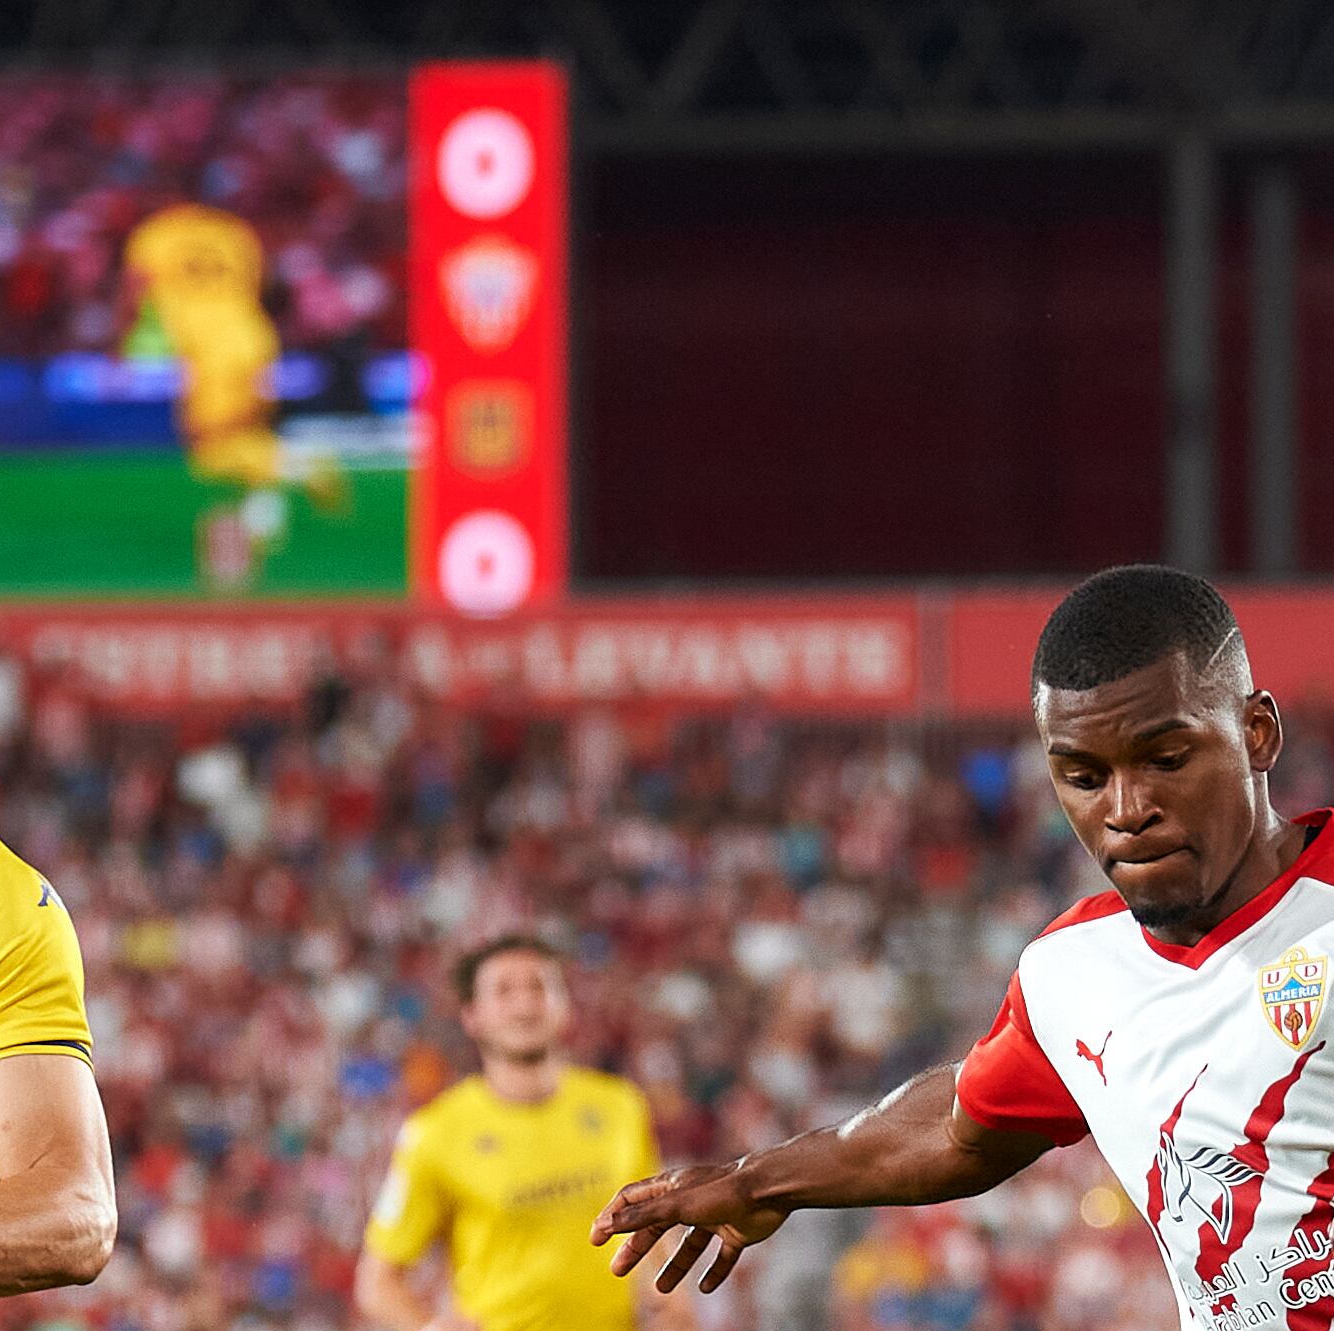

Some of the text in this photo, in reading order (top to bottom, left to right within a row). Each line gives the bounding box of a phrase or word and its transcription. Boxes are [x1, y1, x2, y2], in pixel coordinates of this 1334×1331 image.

[436, 106, 537, 221] 0
[436, 509, 535, 619] 0
[1266, 985, 1319, 1003] ALMERIA
[1304, 965, 1318, 977] D
